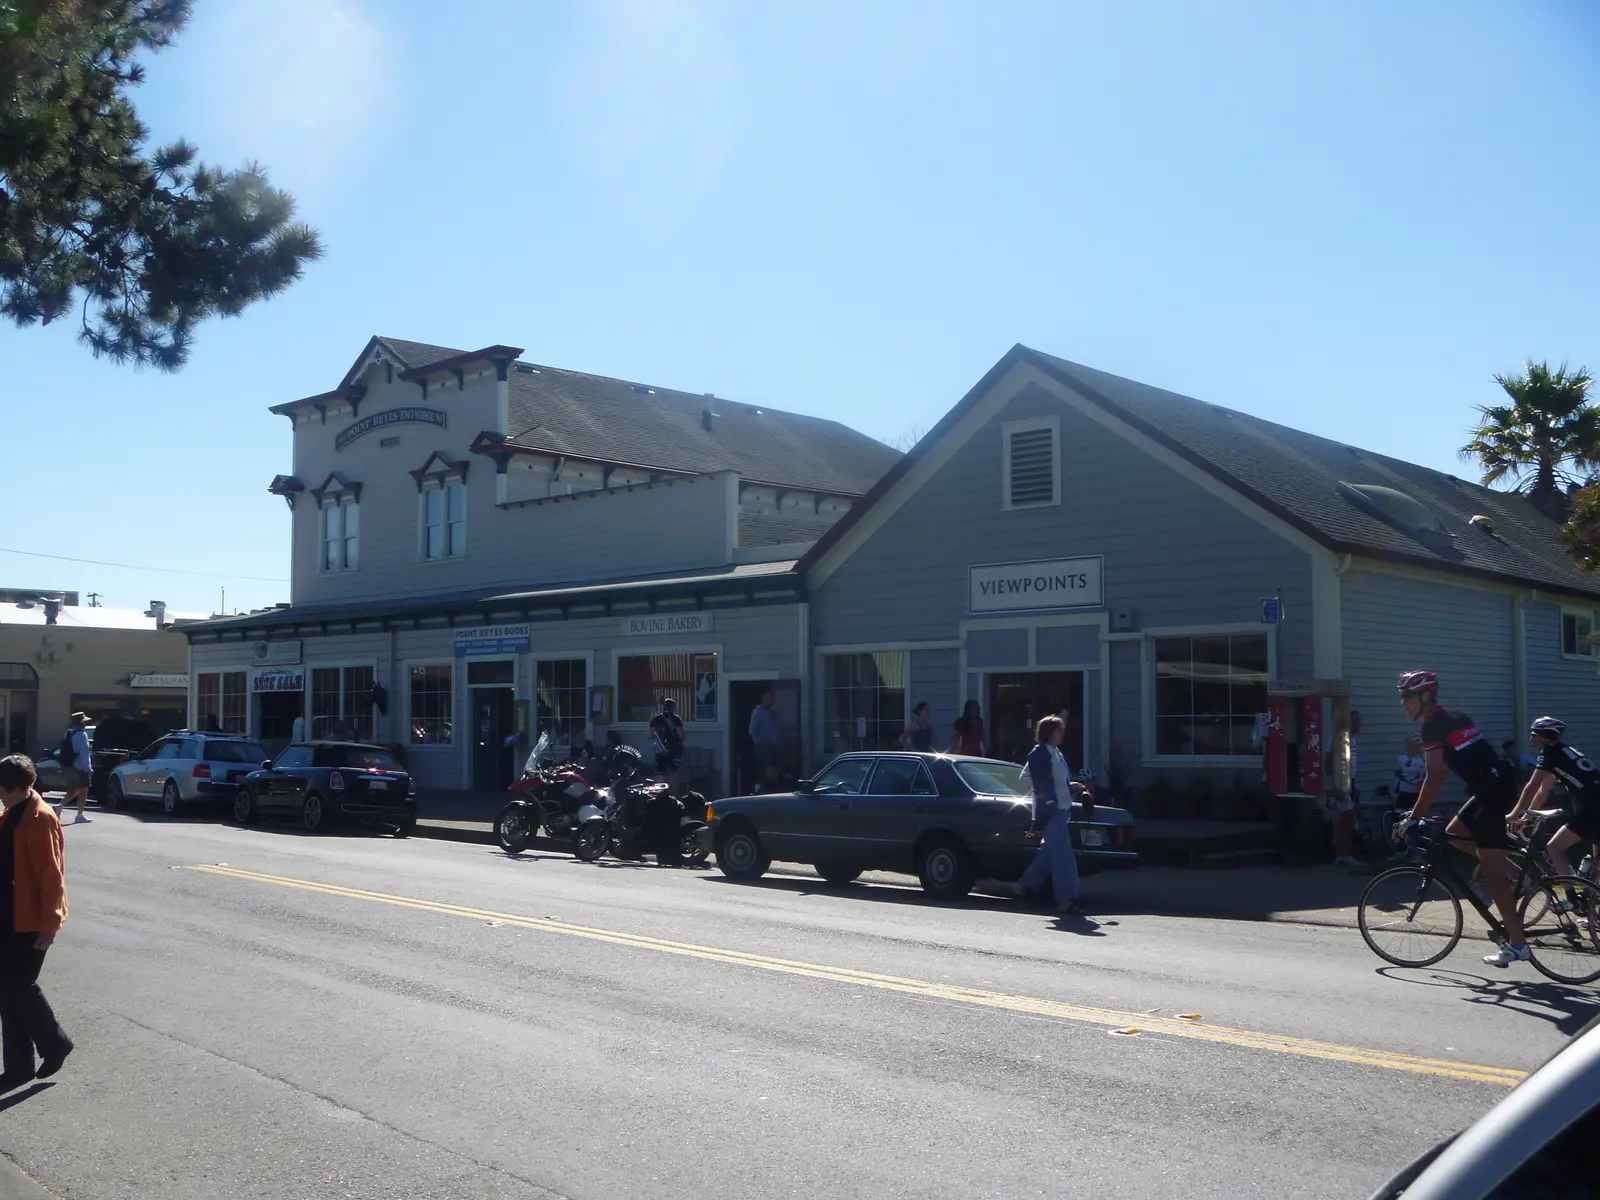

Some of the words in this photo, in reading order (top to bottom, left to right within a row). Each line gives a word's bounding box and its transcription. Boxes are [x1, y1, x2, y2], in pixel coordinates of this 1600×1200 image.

[348, 421, 370, 438] POINT
[980, 573, 1087, 595] VIEWPOINTS
[455, 629, 478, 639] POINT
[480, 627, 502, 637] REYES
[504, 625, 529, 636] BOOKS
[630, 619, 665, 633] BOVINE
[668, 616, 703, 631] BAKERY
